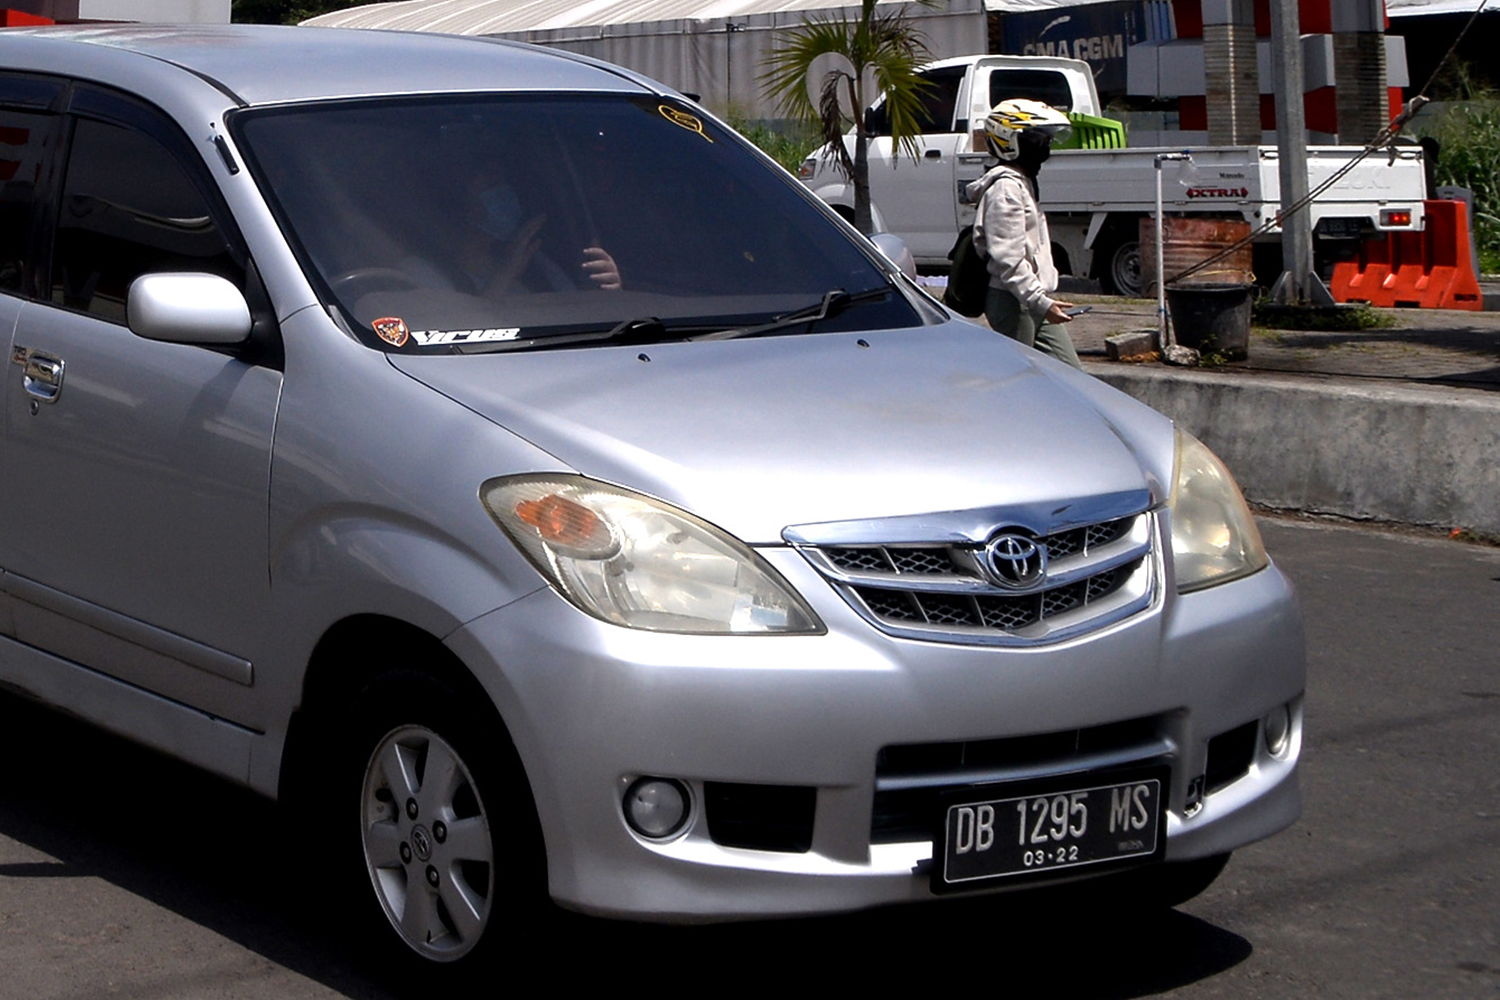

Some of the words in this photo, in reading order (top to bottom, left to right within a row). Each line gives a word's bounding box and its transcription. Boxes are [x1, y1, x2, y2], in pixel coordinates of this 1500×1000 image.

[1073, 34, 1124, 60] CGM
[956, 804, 995, 854] DB
[1016, 792, 1088, 846] 1295
[1108, 783, 1150, 834] MS
